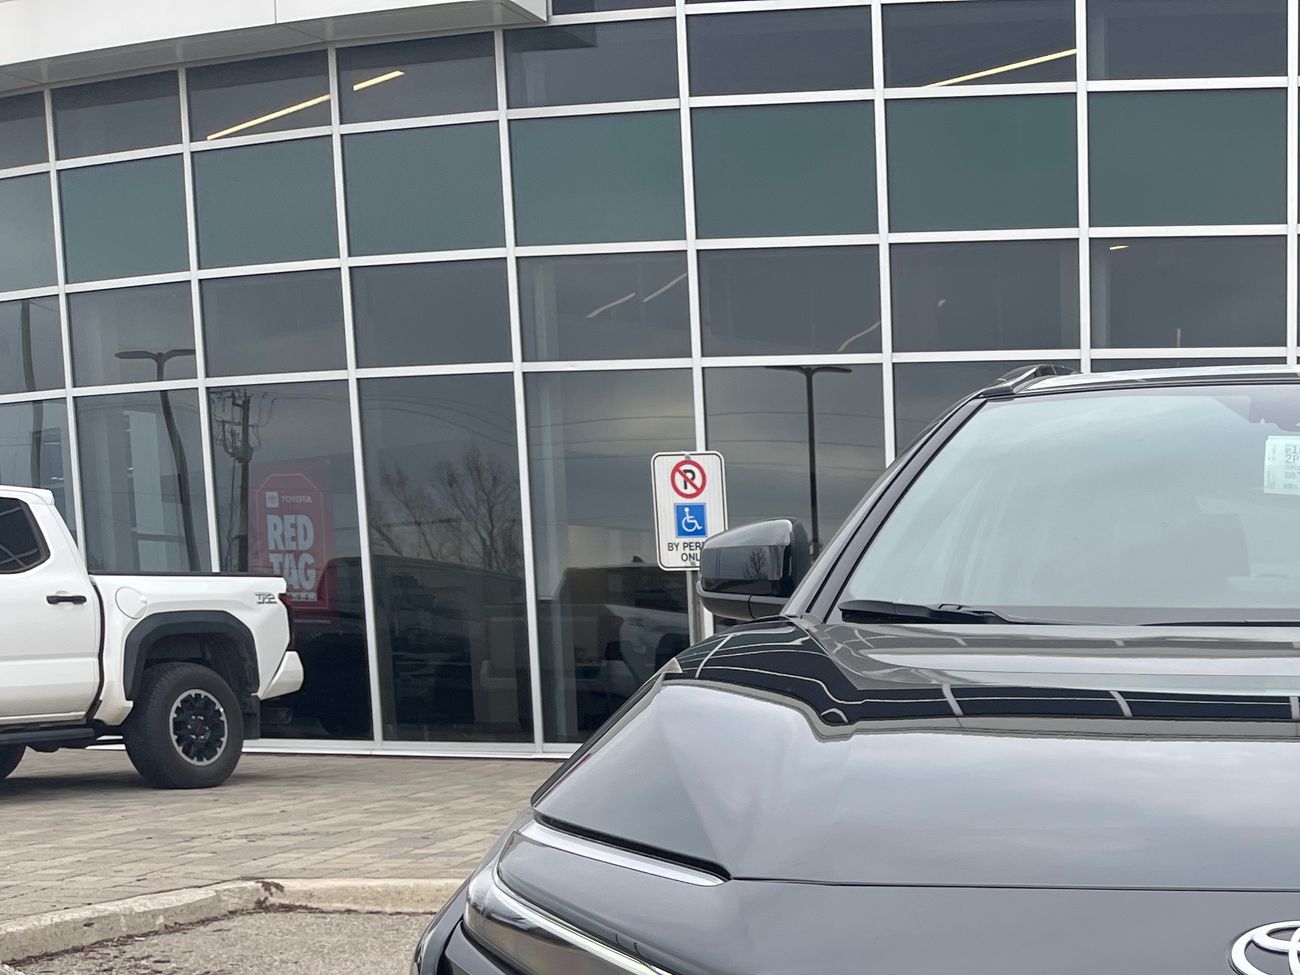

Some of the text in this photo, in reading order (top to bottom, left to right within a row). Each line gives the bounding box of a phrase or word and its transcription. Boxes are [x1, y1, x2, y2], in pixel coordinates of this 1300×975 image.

[682, 469, 696, 490] P
[280, 495, 312, 504] TOYOTA
[266, 514, 314, 551] RED
[667, 541, 704, 551] BY PER
[680, 553, 701, 562] ONL
[269, 552, 317, 591] TAG
